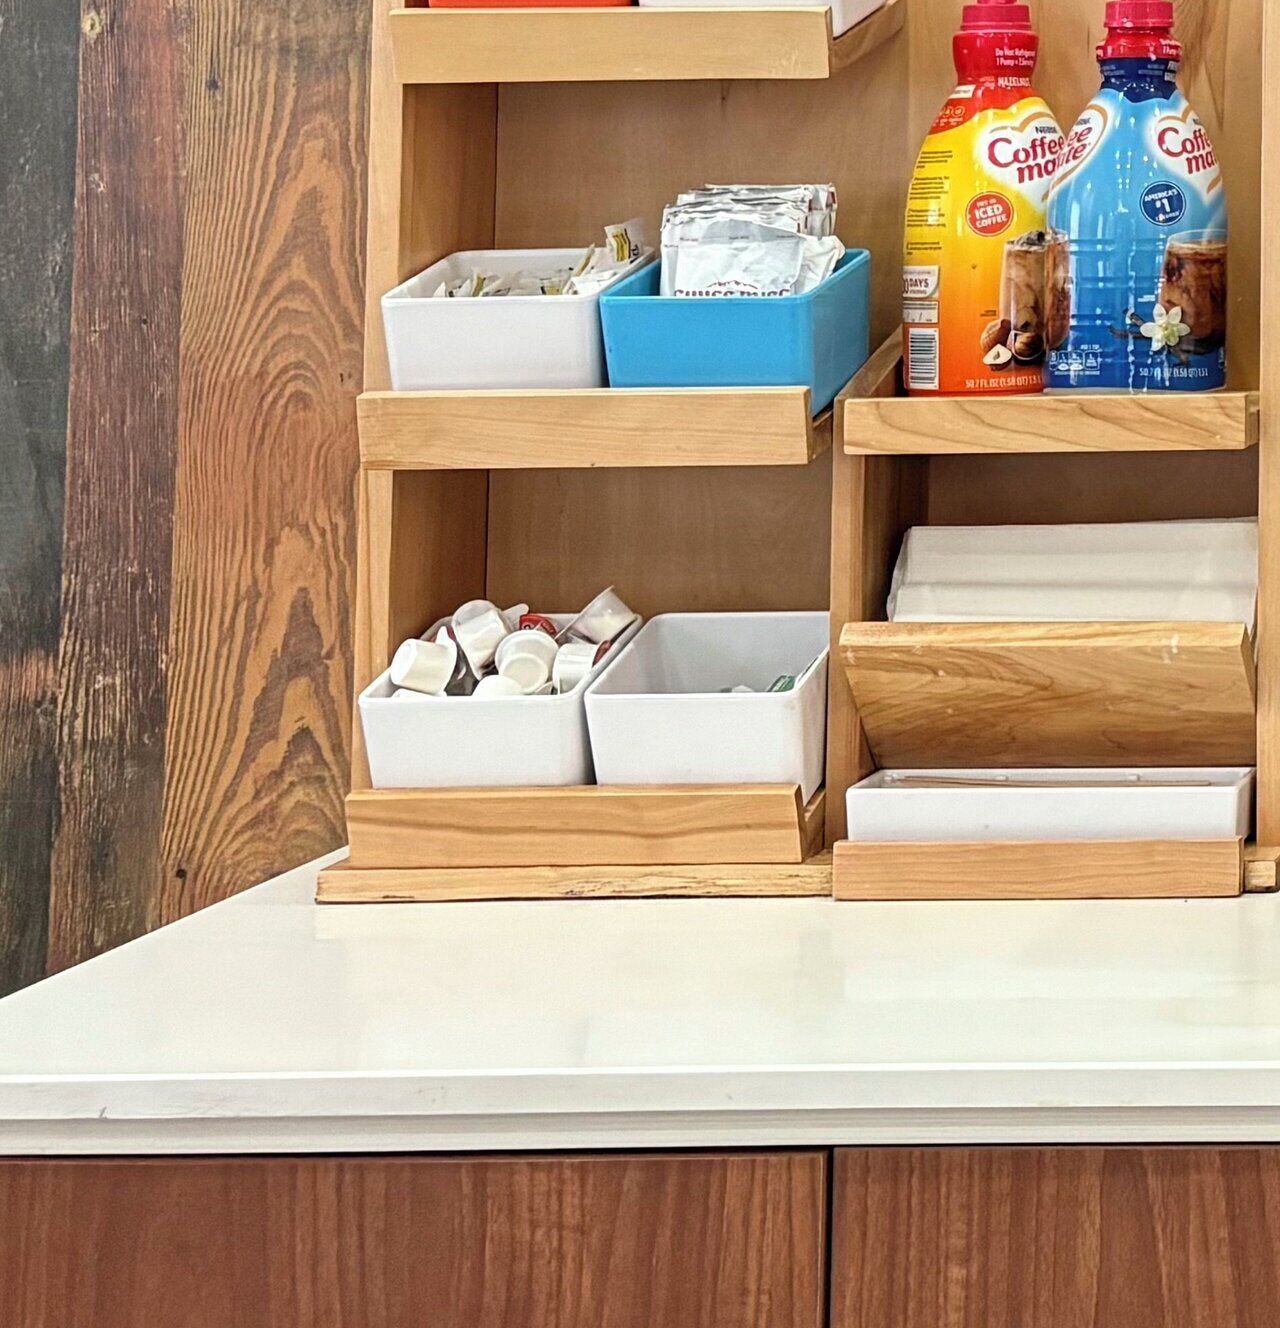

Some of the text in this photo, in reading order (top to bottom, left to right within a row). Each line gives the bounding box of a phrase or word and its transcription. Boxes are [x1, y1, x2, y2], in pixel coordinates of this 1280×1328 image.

[988, 136, 1065, 169] Coffee
[974, 203, 1004, 220] ICED
[975, 213, 1008, 229] COFFEE
[909, 277, 929, 288] DAYS
